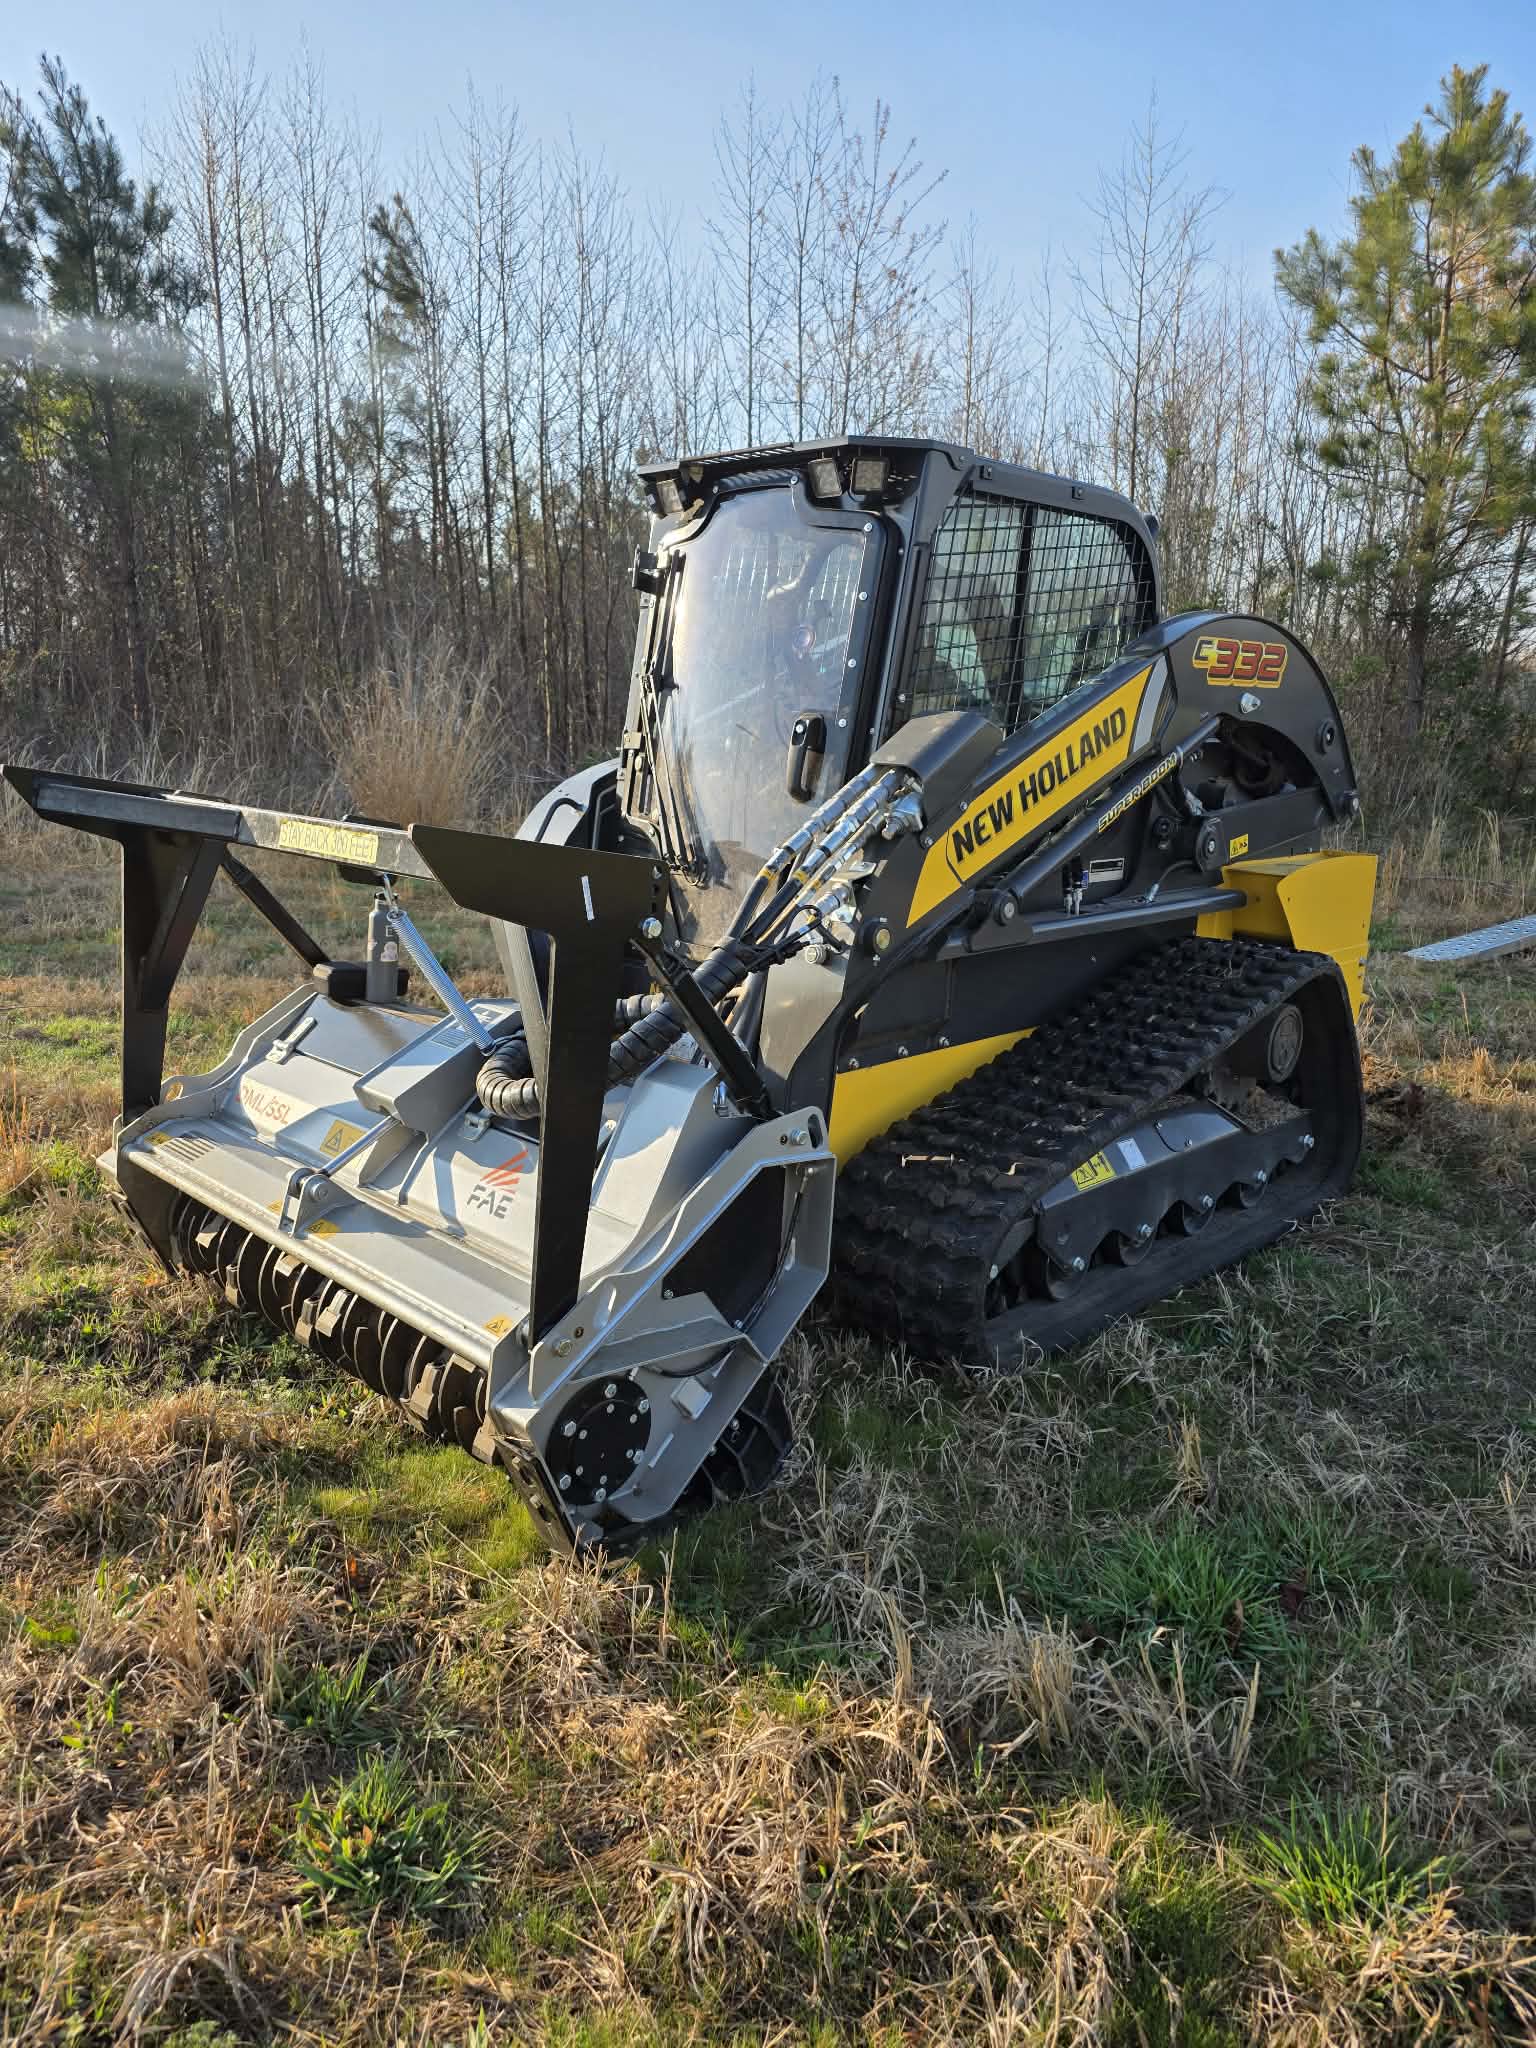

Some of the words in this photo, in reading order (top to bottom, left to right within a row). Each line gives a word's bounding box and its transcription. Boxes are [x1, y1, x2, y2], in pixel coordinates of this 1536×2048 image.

[952, 788, 1014, 863] NEW
[1018, 706, 1126, 815] HOLLAND
[1098, 785, 1142, 833] SUPER
[1141, 752, 1177, 796] BOOM
[281, 821, 304, 848] STAY
[304, 827, 329, 852] BACK
[351, 834, 376, 861] FEET
[467, 1184, 513, 1219] FAE
